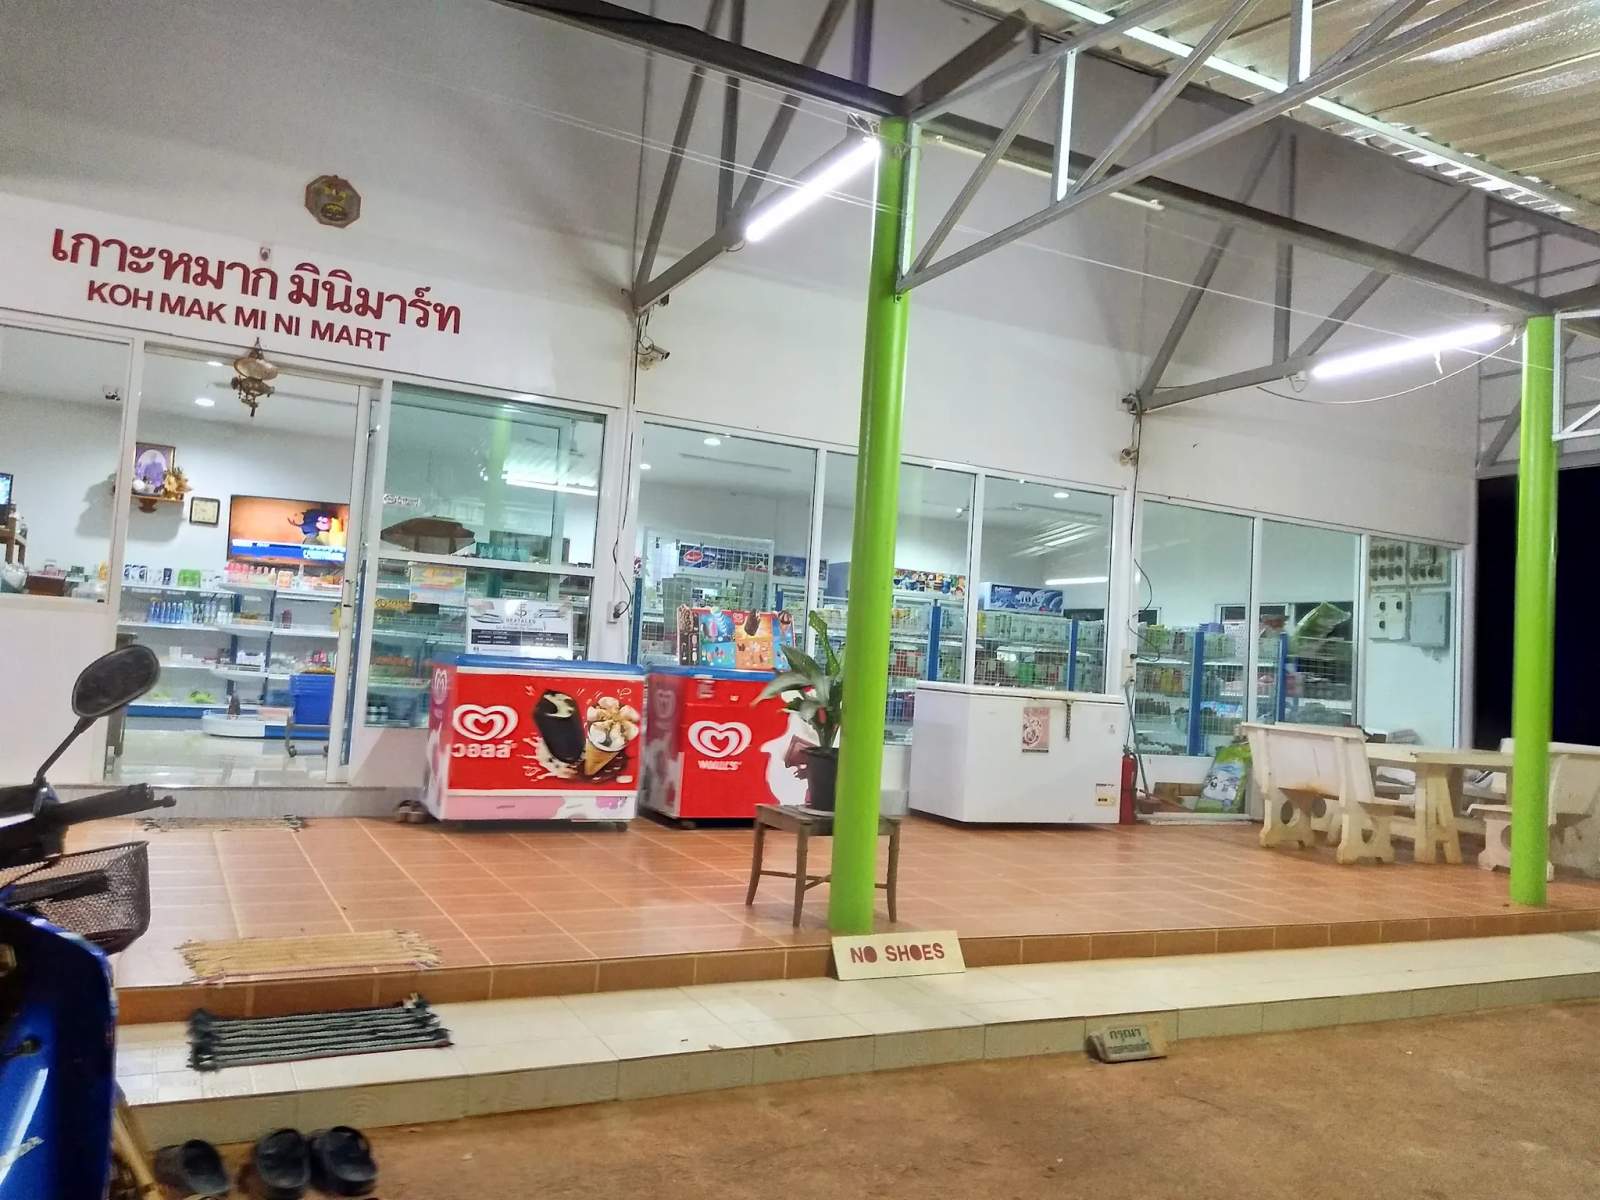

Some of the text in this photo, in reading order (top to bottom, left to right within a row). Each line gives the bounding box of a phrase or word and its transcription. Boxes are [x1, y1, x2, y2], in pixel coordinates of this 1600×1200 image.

[52, 228, 461, 334] เกาะหมาก มินิมาร์ท
[87, 280, 153, 311] KOH
[160, 292, 226, 324] MAK
[311, 320, 391, 352] MART
[850, 942, 945, 963] NO SHOES
